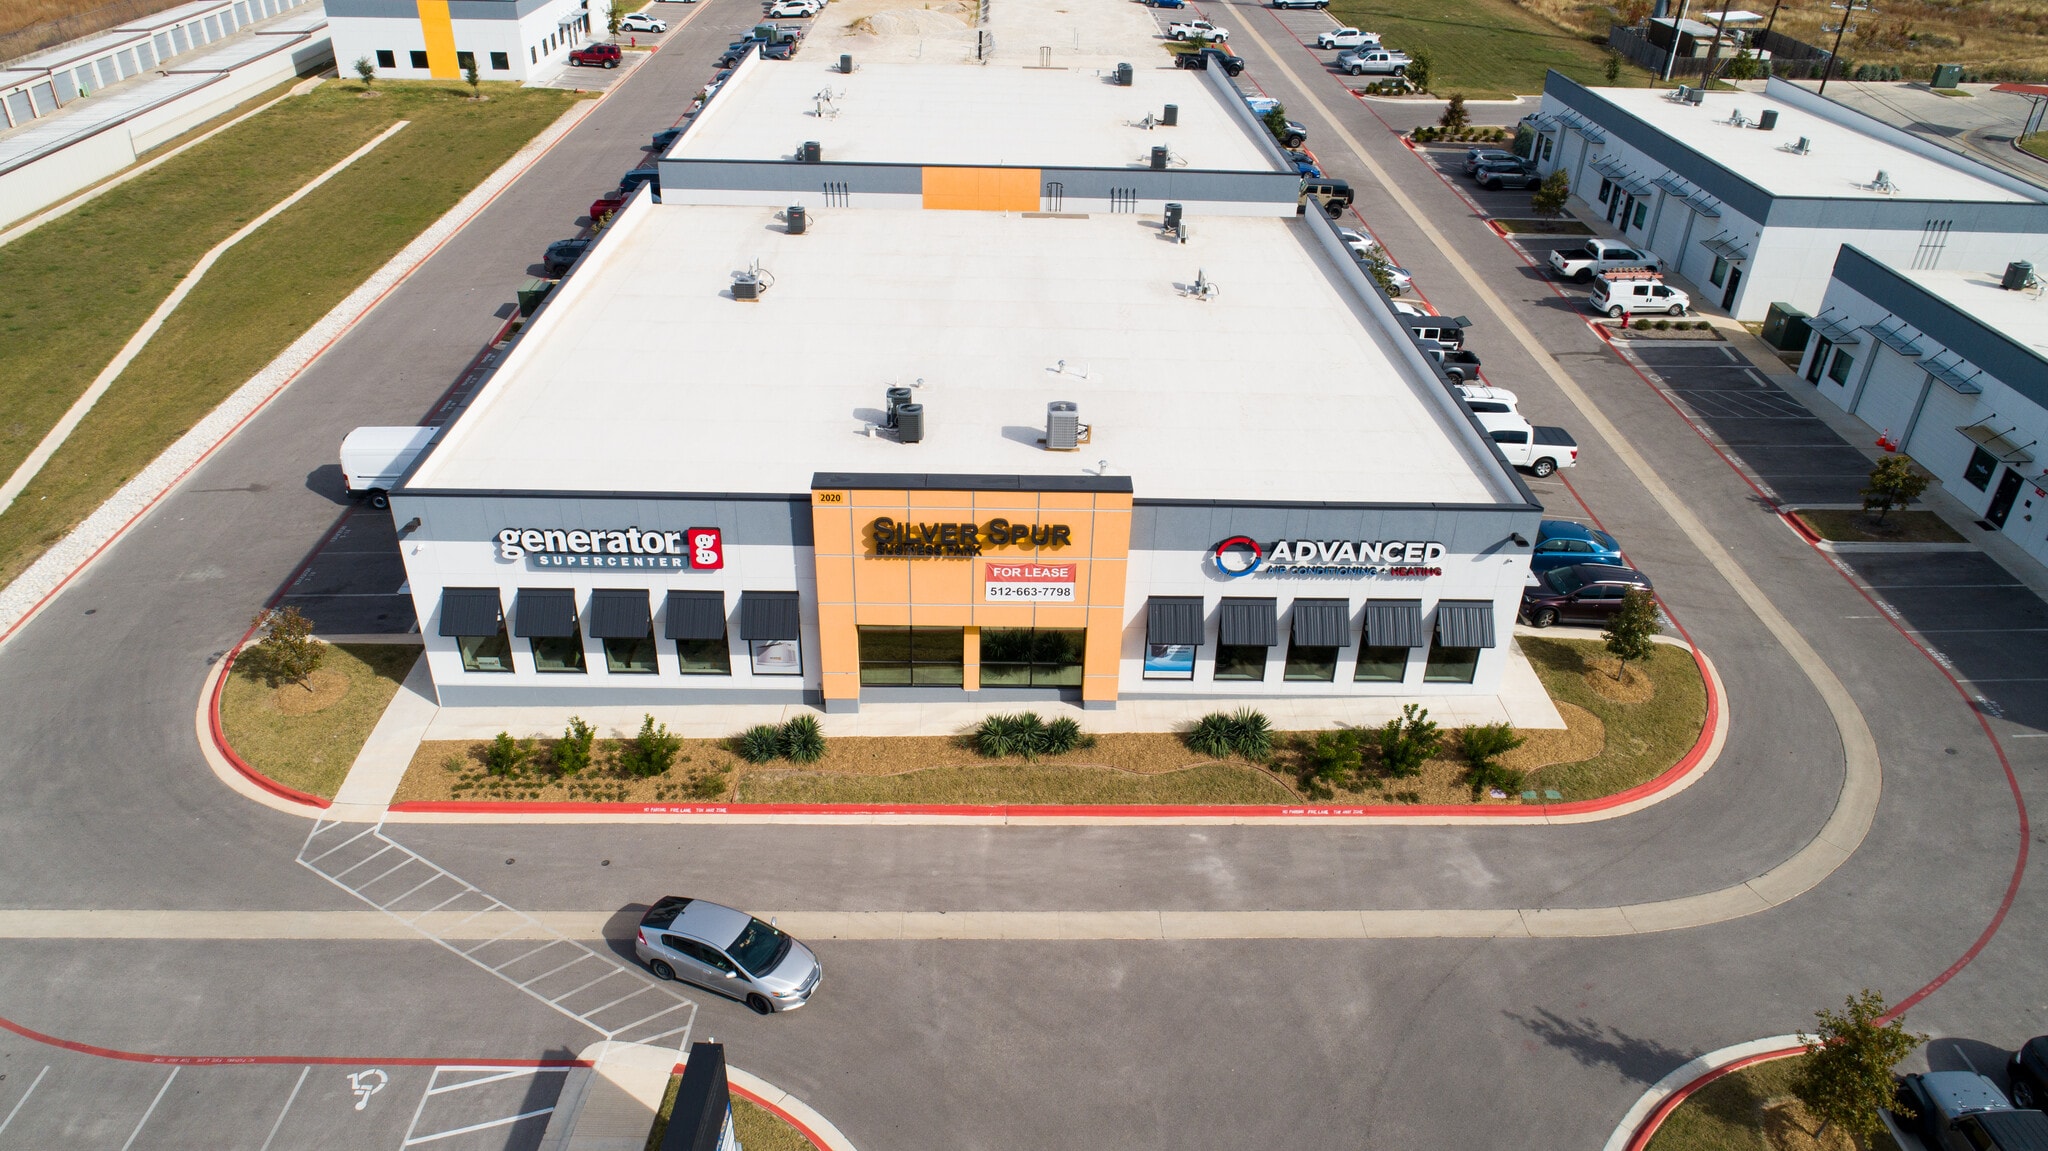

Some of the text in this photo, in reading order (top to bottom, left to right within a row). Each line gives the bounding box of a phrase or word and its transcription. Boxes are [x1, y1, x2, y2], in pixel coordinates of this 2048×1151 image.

[820, 493, 841, 502] 2020
[499, 528, 680, 559] generator
[948, 545, 982, 556] PARK
[1269, 541, 1446, 562] ADVANCED
[539, 556, 682, 567] SUPERCENTER
[993, 567, 1069, 578] FOR LEASE
[1267, 566, 1287, 575] AIR
[1290, 566, 1377, 576] CONDITIONING
[1391, 567, 1442, 576] HEATING
[990, 587, 1071, 597] 512-663-7798
